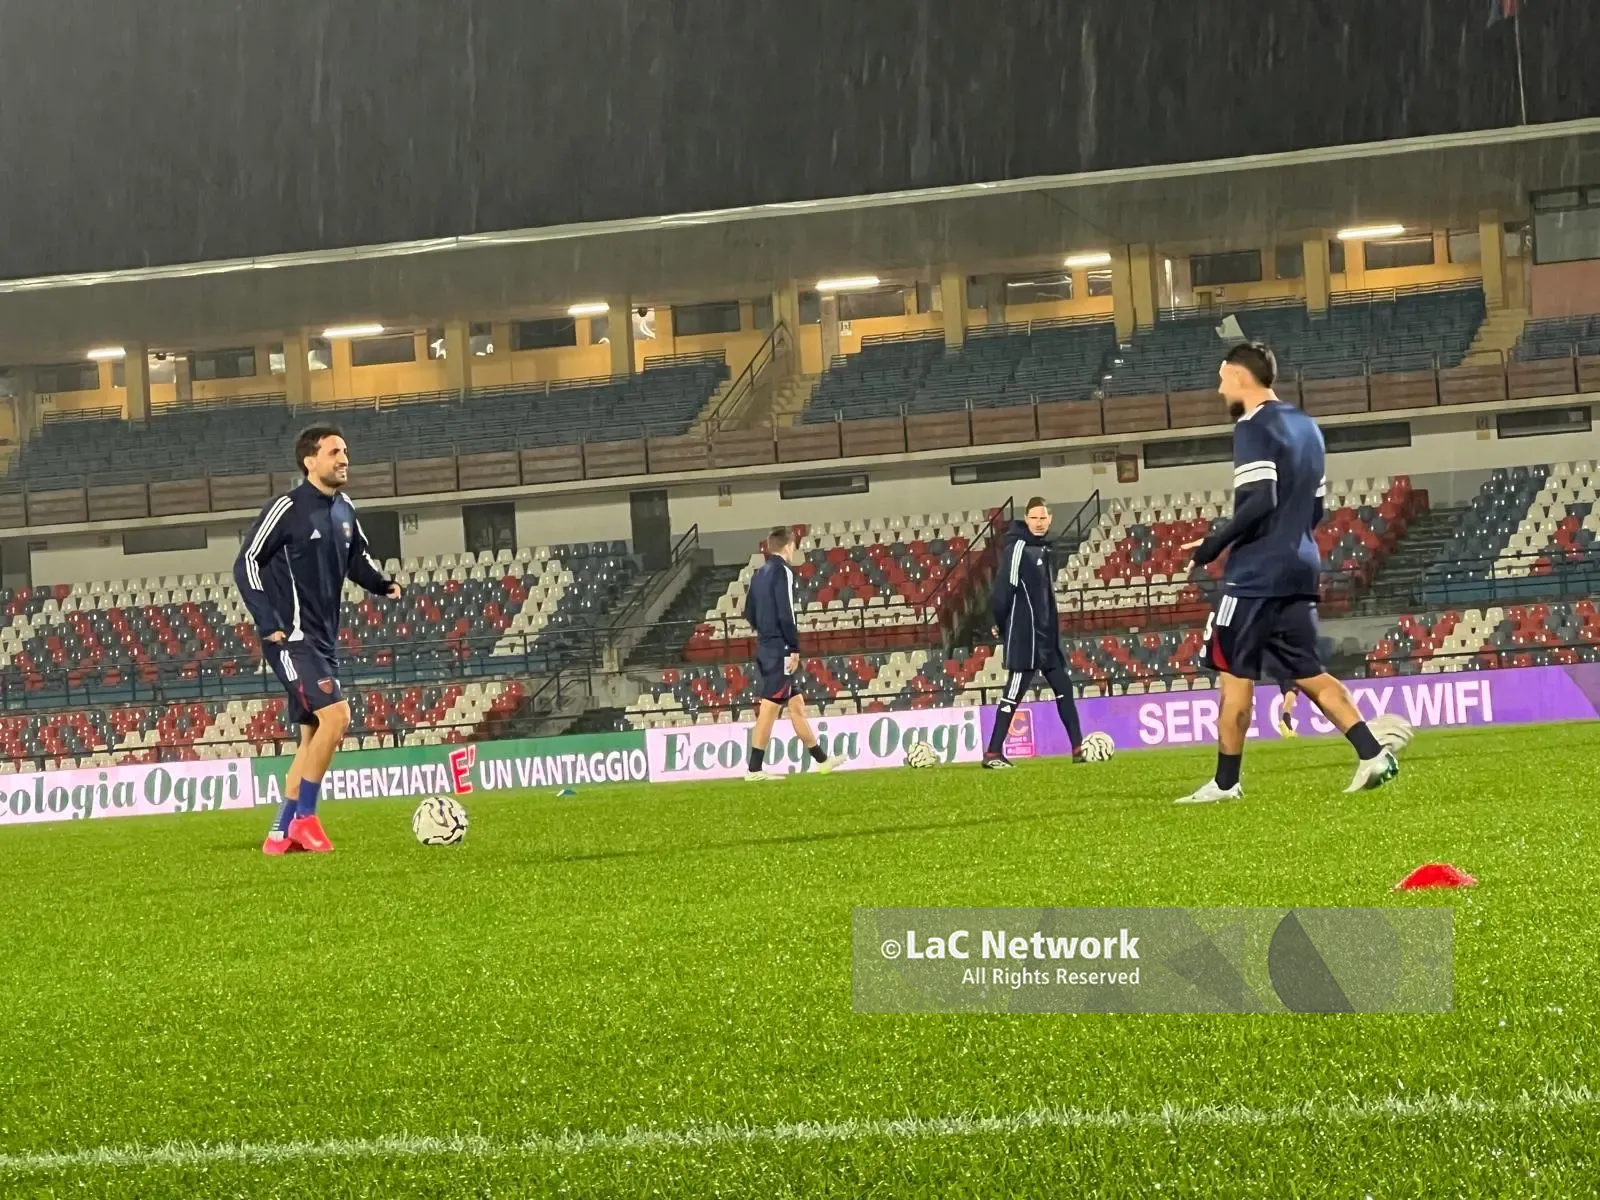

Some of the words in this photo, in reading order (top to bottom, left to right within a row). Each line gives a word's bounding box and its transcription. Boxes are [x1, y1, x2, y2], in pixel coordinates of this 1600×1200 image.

[869, 711, 978, 764] Oggi
[1139, 696, 1259, 745] SER
[1402, 680, 1493, 727] WIFI
[144, 762, 240, 812] Oggi
[253, 774, 282, 805] LA
[284, 763, 450, 801] FERENZIATA
[479, 759, 513, 789] UN
[515, 749, 647, 787] VANTAGGIO
